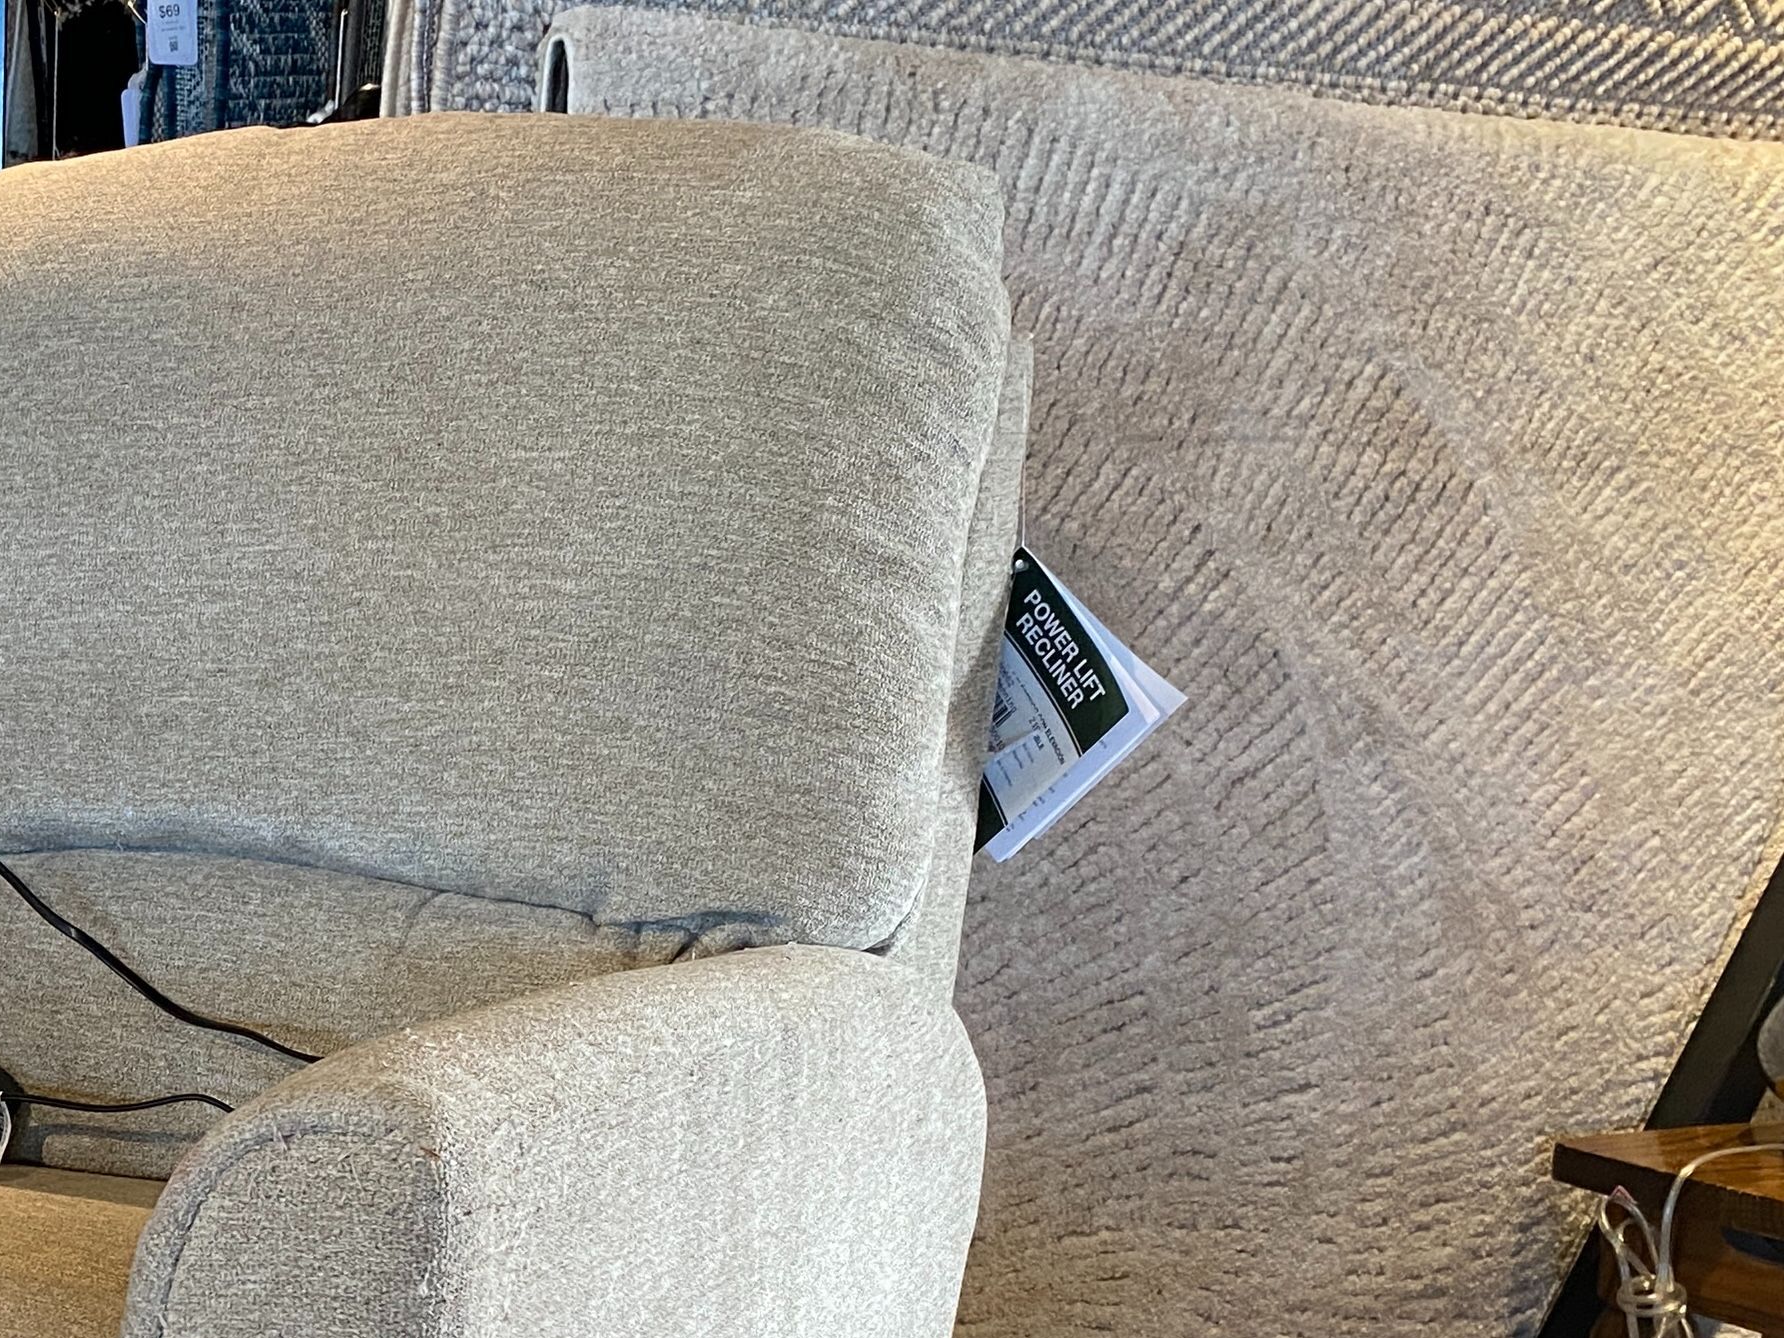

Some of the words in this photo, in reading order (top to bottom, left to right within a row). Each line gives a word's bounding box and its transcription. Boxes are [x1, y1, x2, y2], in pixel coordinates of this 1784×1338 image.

[158, 4, 180, 19] $69
[1016, 613, 1084, 710] RECLINER
[1024, 589, 1080, 663] POWER
[1073, 659, 1106, 701] LIFT
